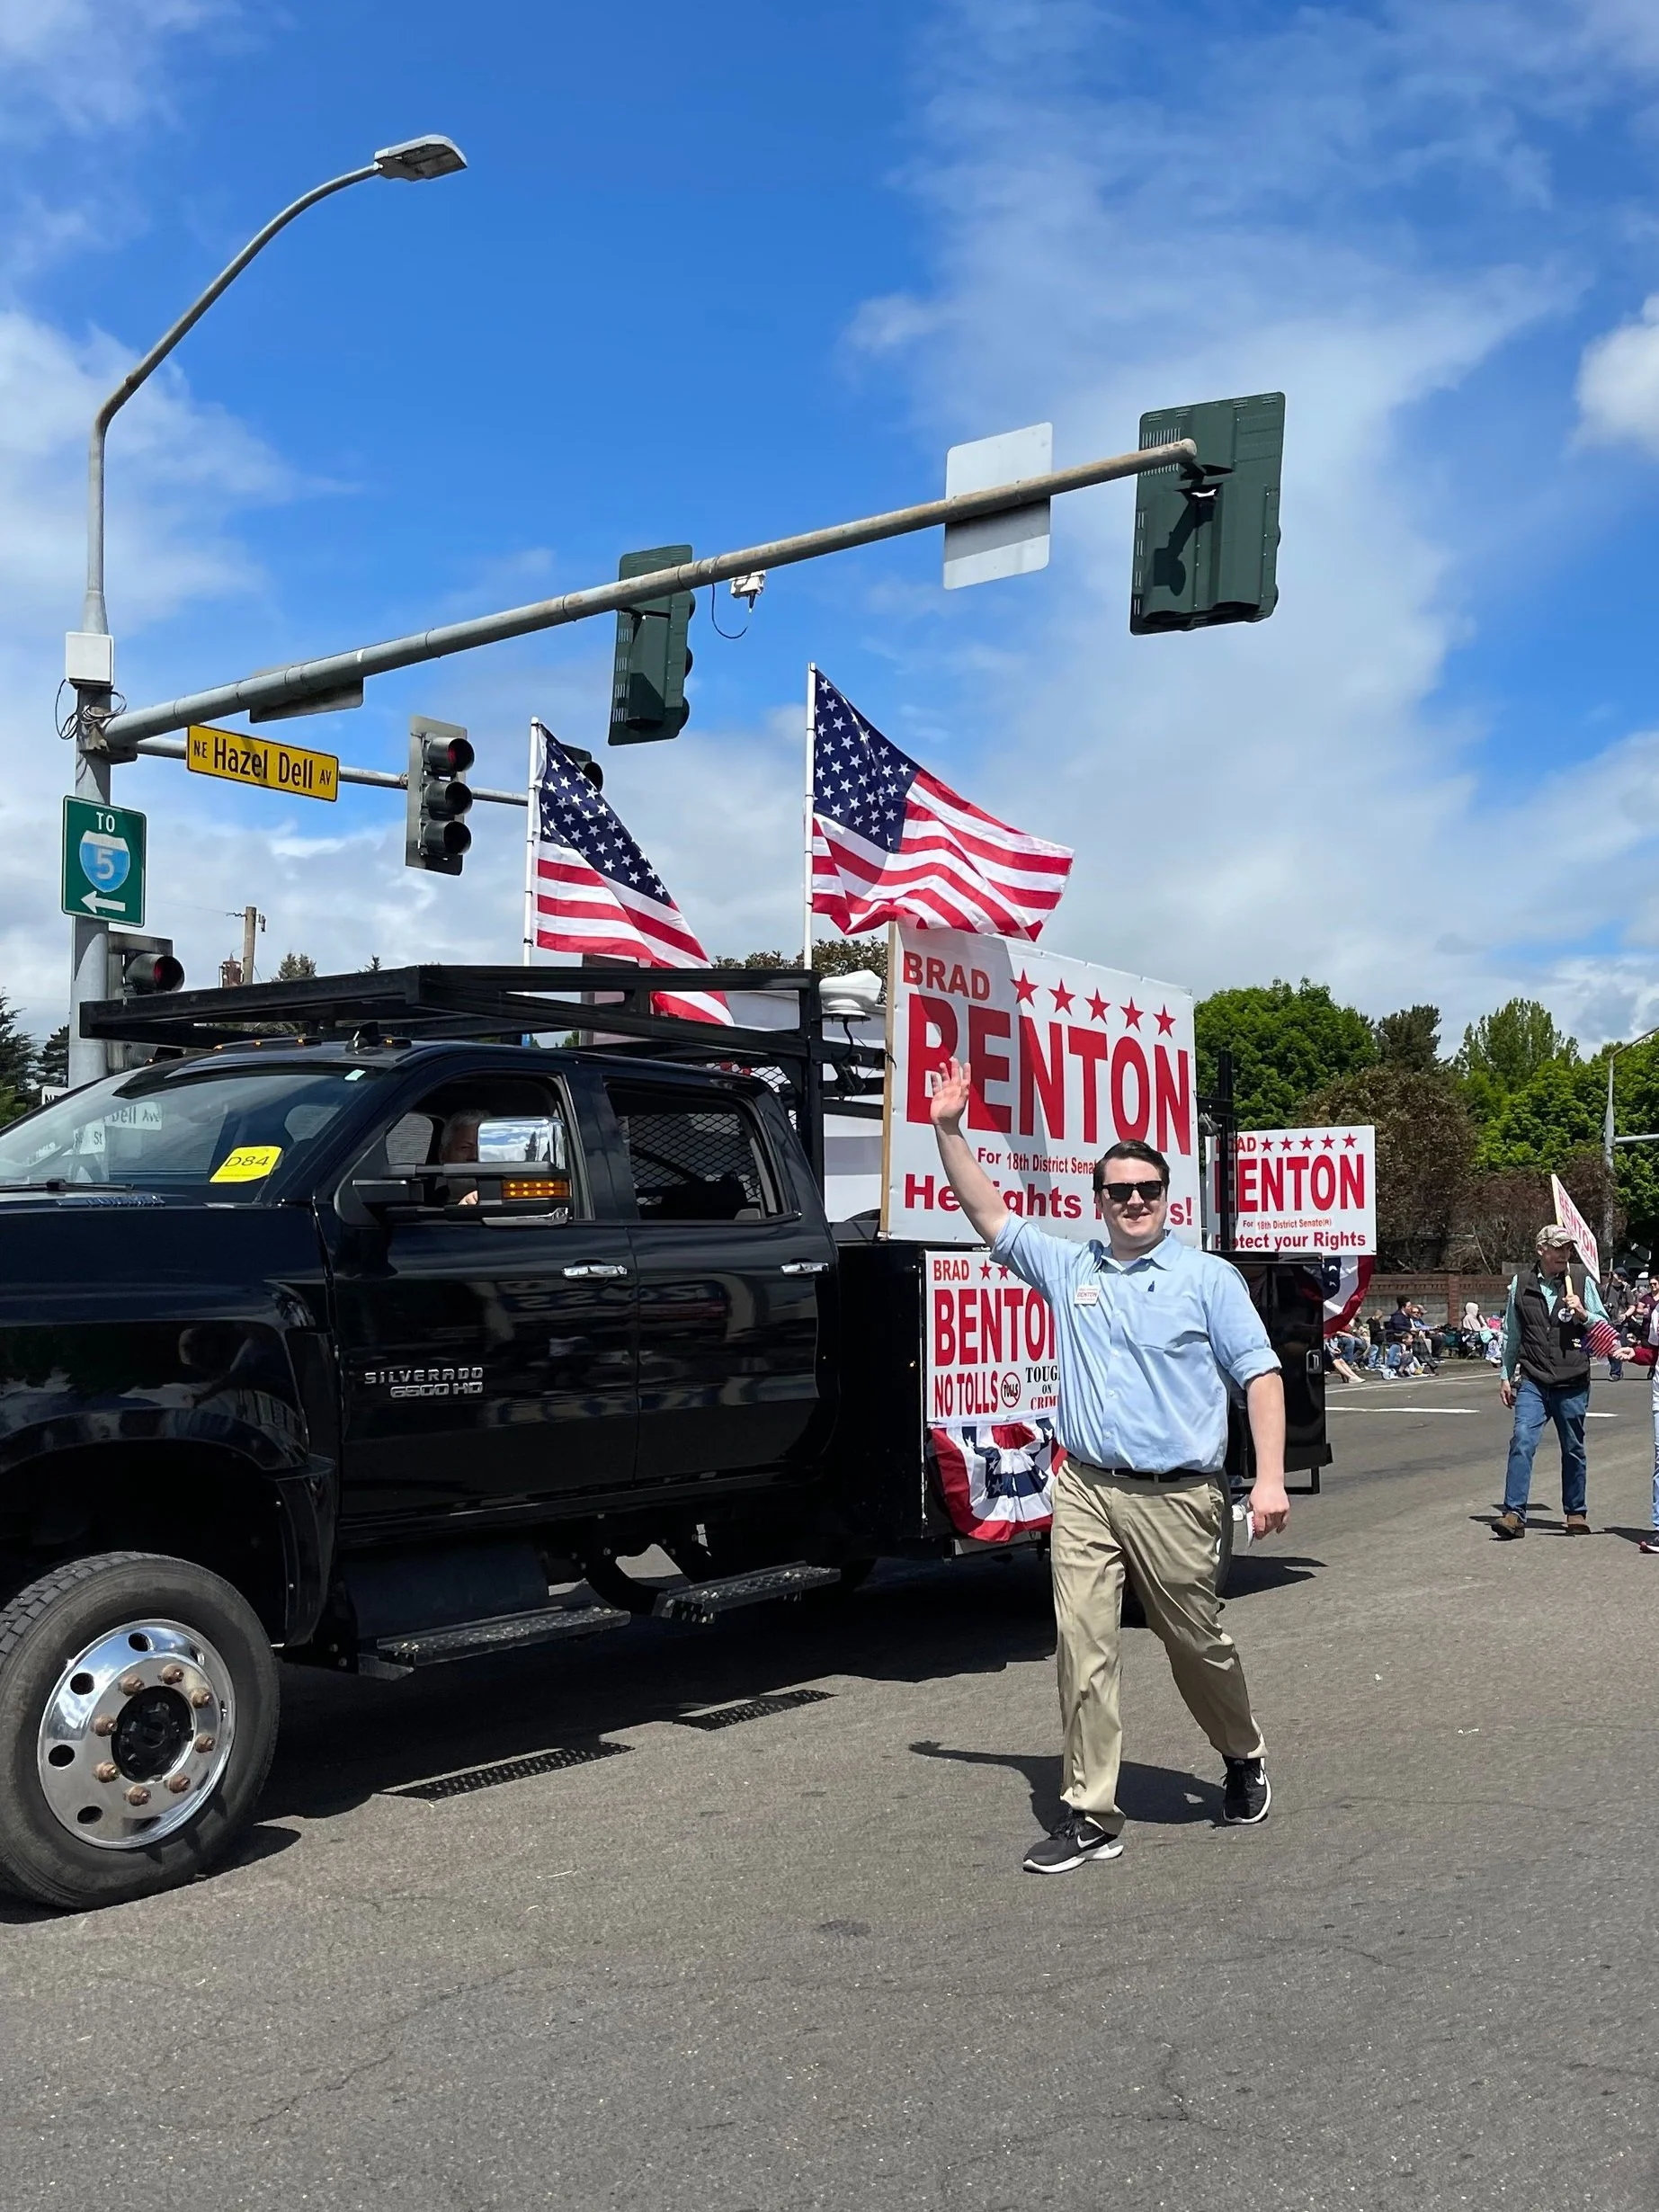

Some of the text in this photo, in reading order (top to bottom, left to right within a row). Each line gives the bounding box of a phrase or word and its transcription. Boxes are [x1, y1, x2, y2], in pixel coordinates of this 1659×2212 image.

[193, 736, 332, 789] NE Hazel Dell AV
[95, 811, 115, 833] TO
[96, 847, 115, 880] 5
[903, 950, 991, 1002] BRAD
[906, 993, 1191, 1156] BENTON
[93, 1130, 103, 1146] St
[224, 1155, 271, 1167] D84
[977, 1146, 1002, 1165] For
[1006, 1152, 1030, 1172] 18th
[1034, 1154, 1069, 1174] District
[1243, 1219, 1253, 1228] For
[1272, 1219, 1298, 1229] District
[1274, 1235, 1308, 1252] your
[1314, 1231, 1366, 1251] Rights
[933, 1259, 970, 1281] BRAD
[363, 1367, 484, 1385] SILVERADO
[1025, 1365, 1060, 1384] TOUG
[389, 1381, 484, 1398] 6500 HD
[934, 1369, 999, 1418] NO TOLLS
[1041, 1384, 1052, 1395] ON
